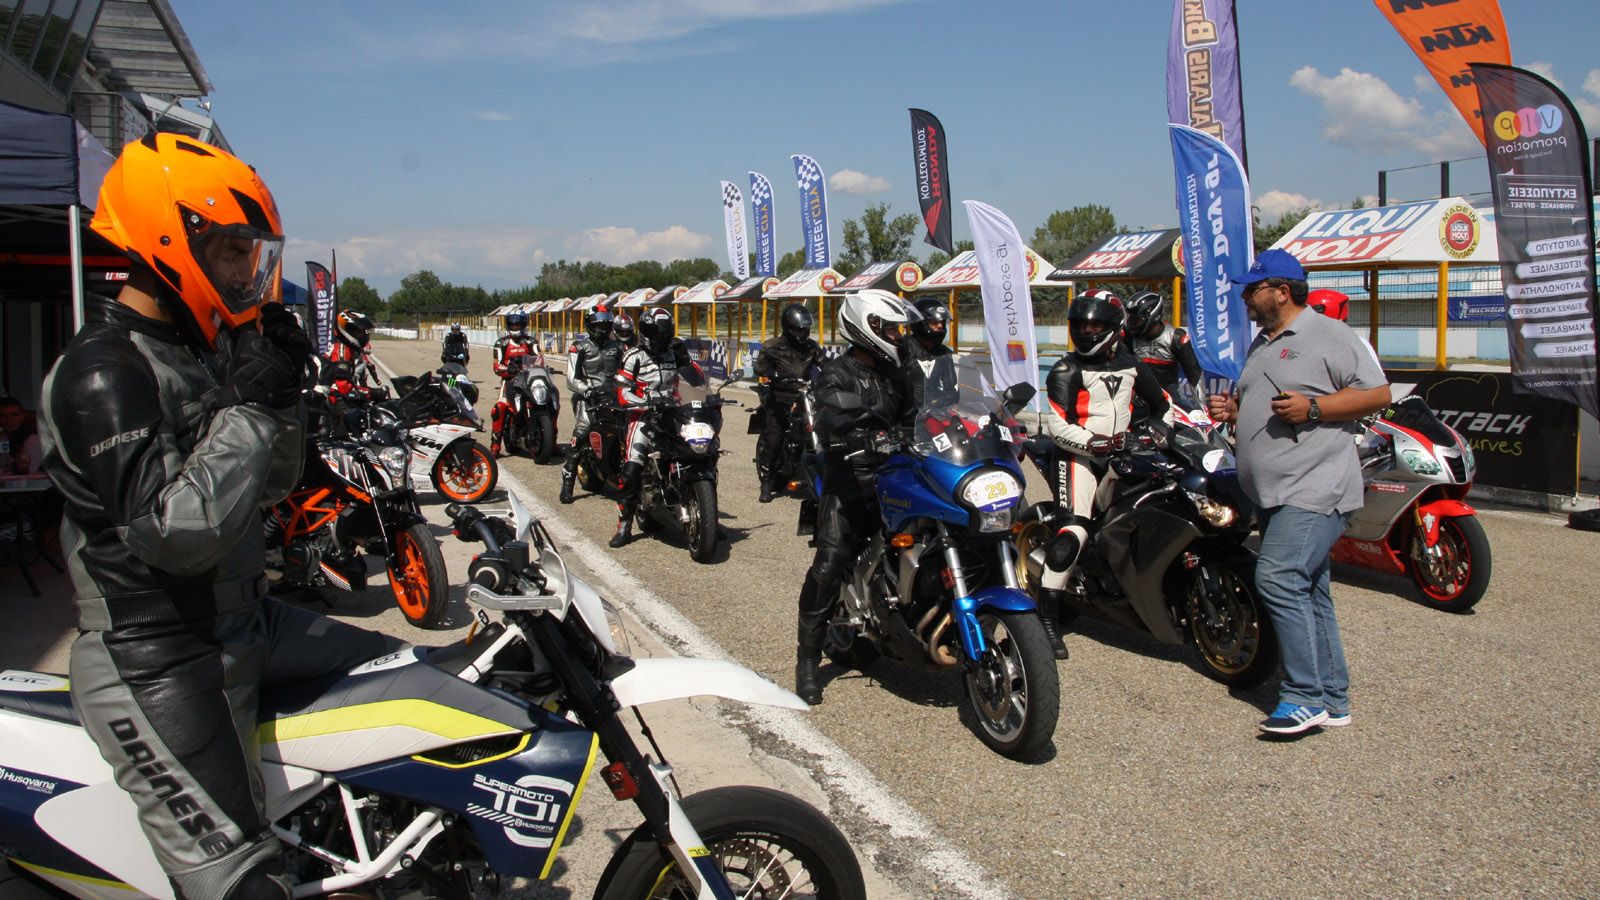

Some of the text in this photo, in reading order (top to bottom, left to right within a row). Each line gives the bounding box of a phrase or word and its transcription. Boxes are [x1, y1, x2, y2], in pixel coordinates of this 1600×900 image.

[1303, 204, 1431, 238] LIQUI
[1442, 205, 1477, 223] MADE IN
[1099, 232, 1163, 252] LIQUI
[1287, 232, 1400, 262] MOLY
[1441, 237, 1477, 259] GERMANY
[1076, 250, 1142, 269] MOLY
[985, 481, 1008, 500] 29
[3, 772, 56, 790] Husqvarna
[474, 773, 555, 802] SUPERMOTO
[473, 782, 561, 823] 701
[522, 822, 554, 831] Husqvarna
